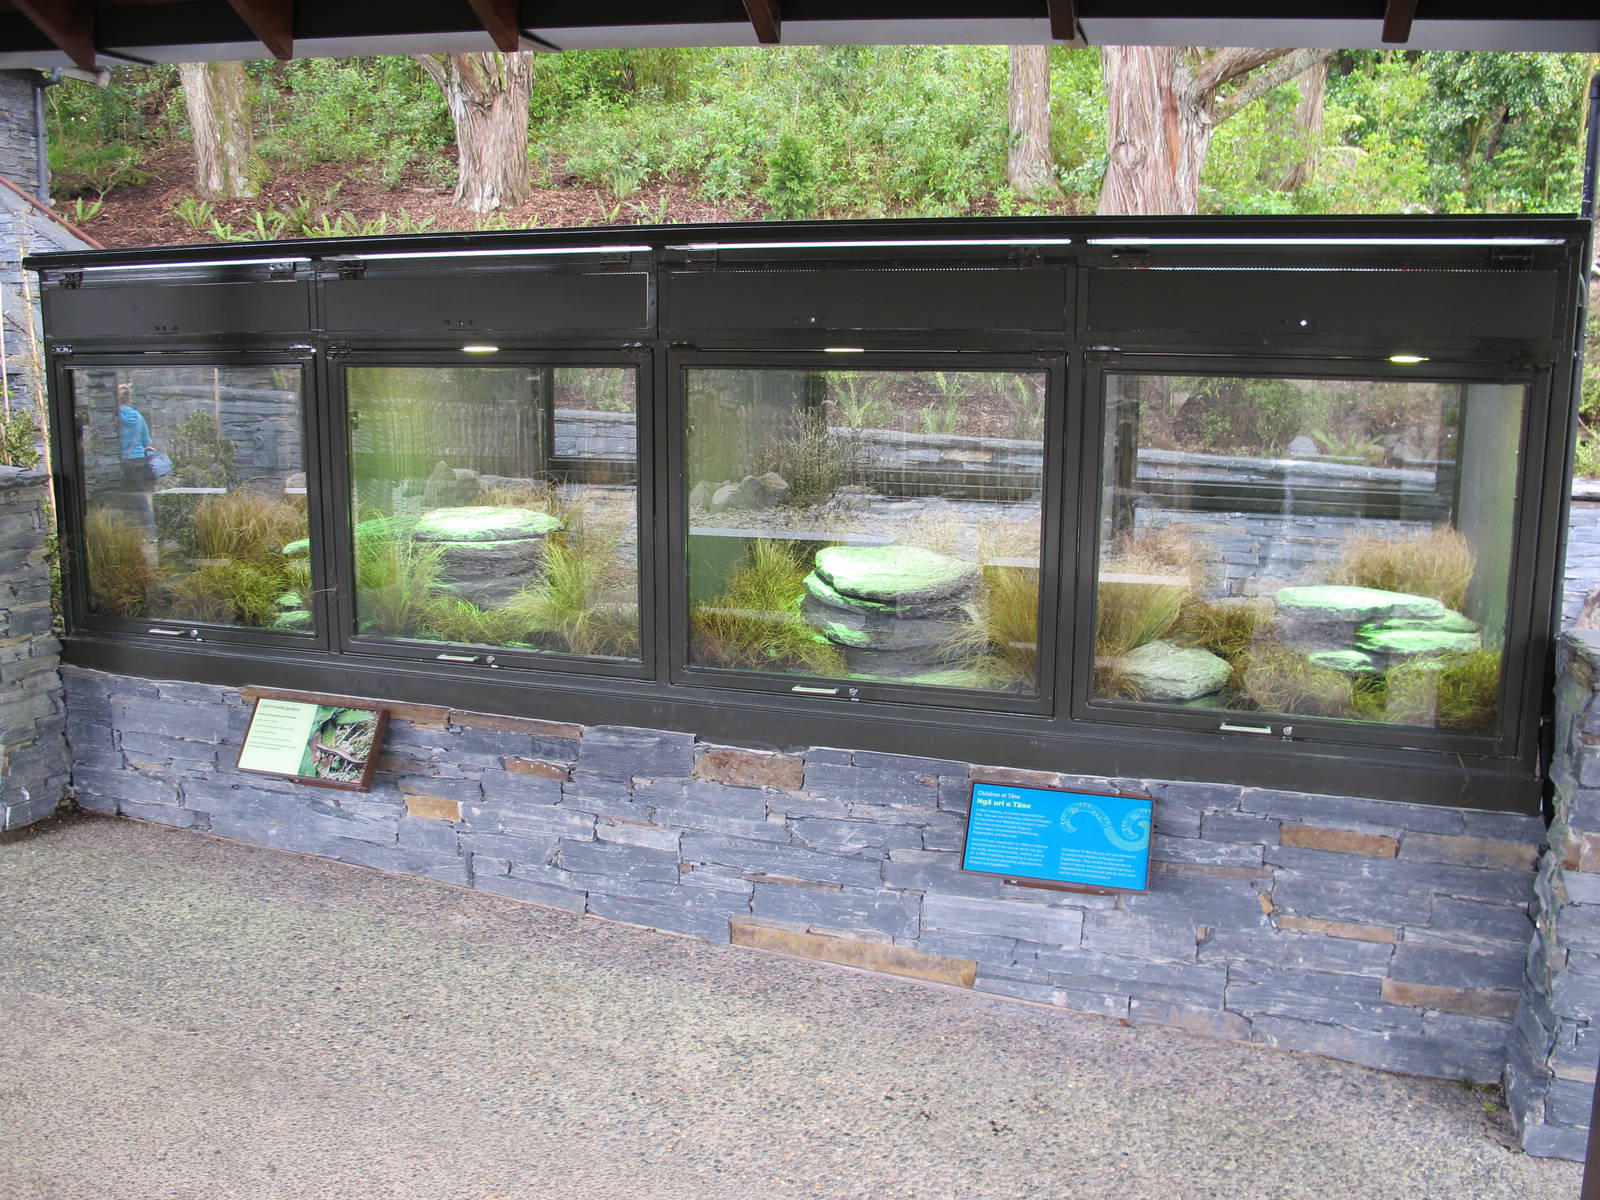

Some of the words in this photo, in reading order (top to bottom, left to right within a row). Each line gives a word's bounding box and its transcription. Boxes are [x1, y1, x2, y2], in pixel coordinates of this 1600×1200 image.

[977, 790, 1000, 798] Children
[976, 797, 992, 806] Ngā
[1013, 801, 1032, 809] Tāne
